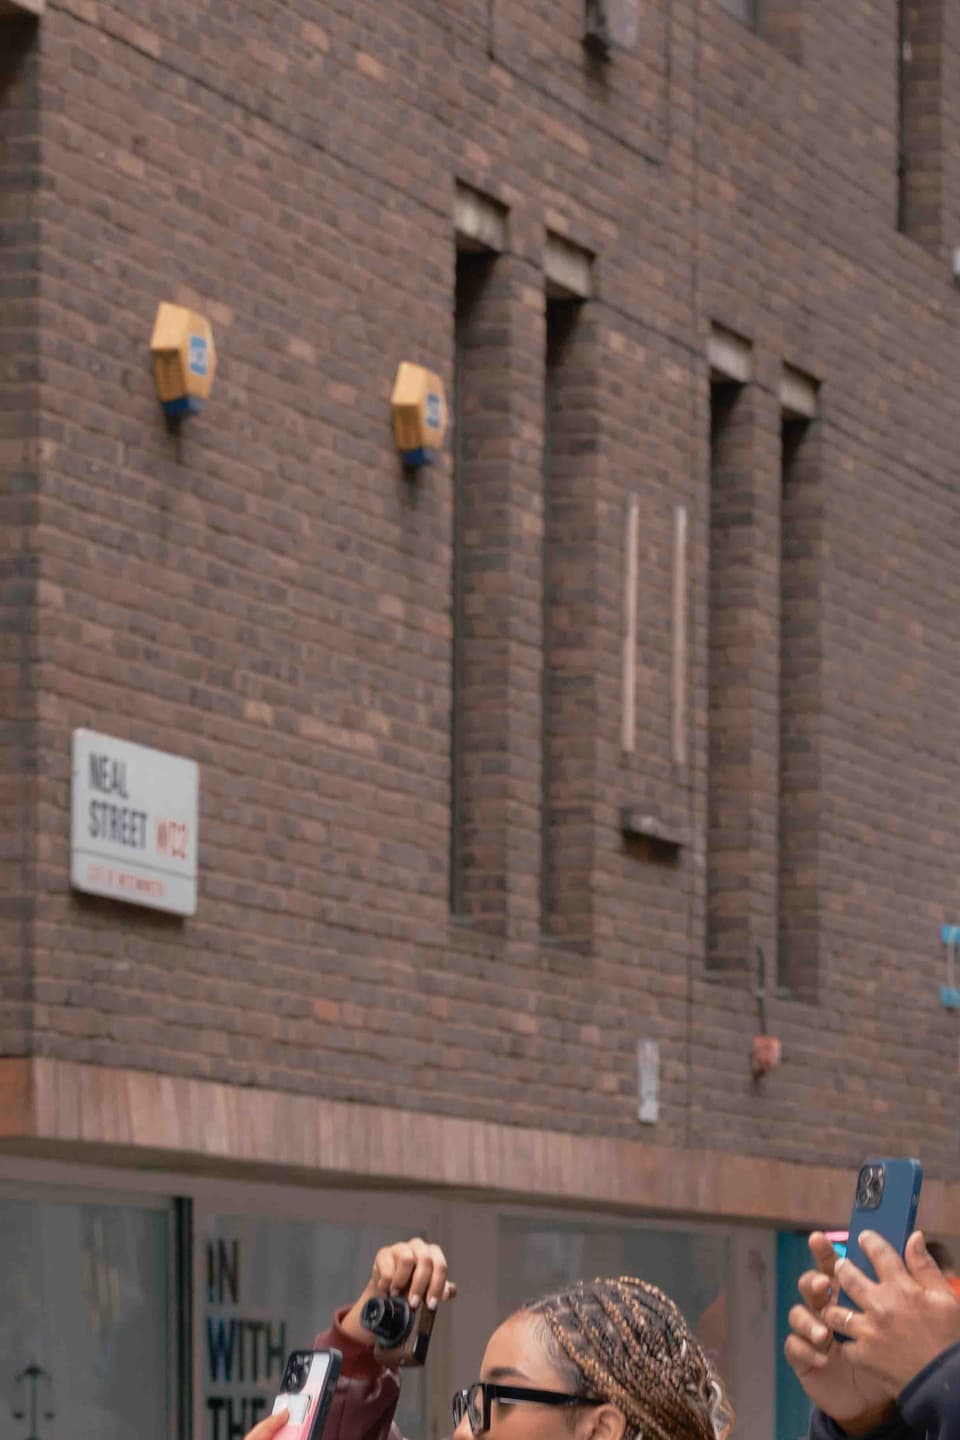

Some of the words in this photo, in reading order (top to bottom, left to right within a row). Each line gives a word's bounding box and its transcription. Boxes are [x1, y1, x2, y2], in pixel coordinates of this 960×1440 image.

[88, 753, 128, 799] NEAL
[88, 800, 148, 849] STREET
[207, 1239, 239, 1304] IN
[206, 1316, 287, 1383] WITH
